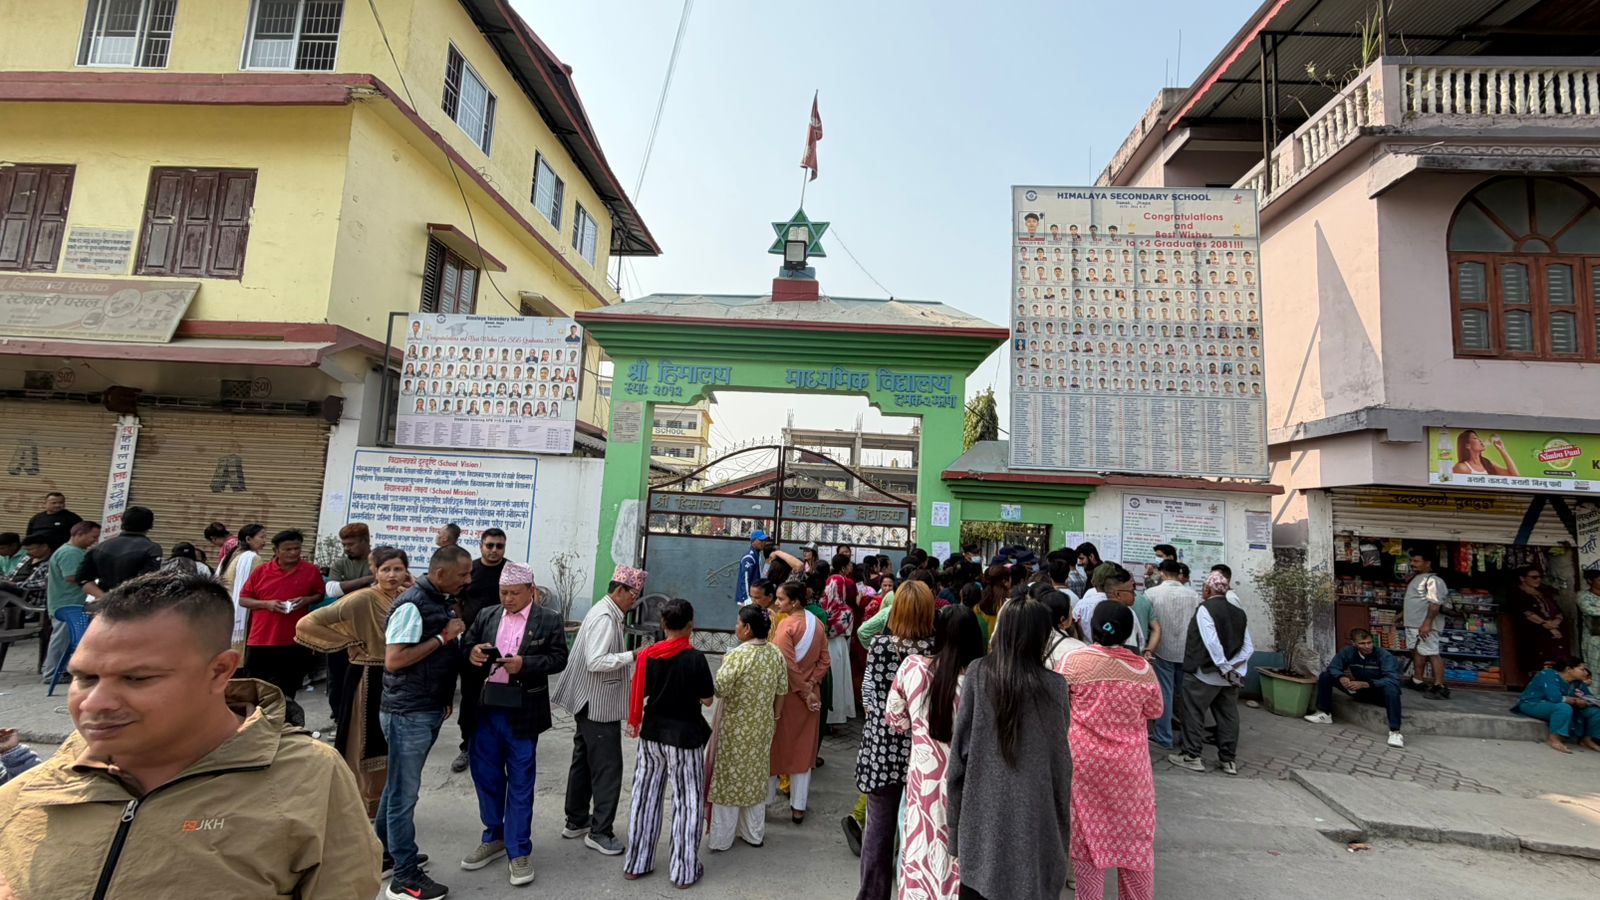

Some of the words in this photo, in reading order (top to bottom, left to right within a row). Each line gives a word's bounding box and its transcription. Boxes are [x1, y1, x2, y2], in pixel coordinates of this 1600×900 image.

[1144, 212, 1224, 221] Congratulations
[1154, 240, 1207, 248] Graduates
[628, 360, 648, 380] श्री
[658, 362, 732, 386] हिमालय
[786, 366, 870, 392] माध्यमिक
[875, 368, 952, 395] विद्यालय
[653, 386, 682, 398] २०१२
[1540, 452, 1564, 460] Nimbu
[1564, 448, 1581, 457] Pani
[675, 496, 724, 512] हिमालय
[791, 504, 846, 518] माध्यमिक
[856, 507, 904, 521] विद्यालय
[196, 818, 224, 831] JKH
